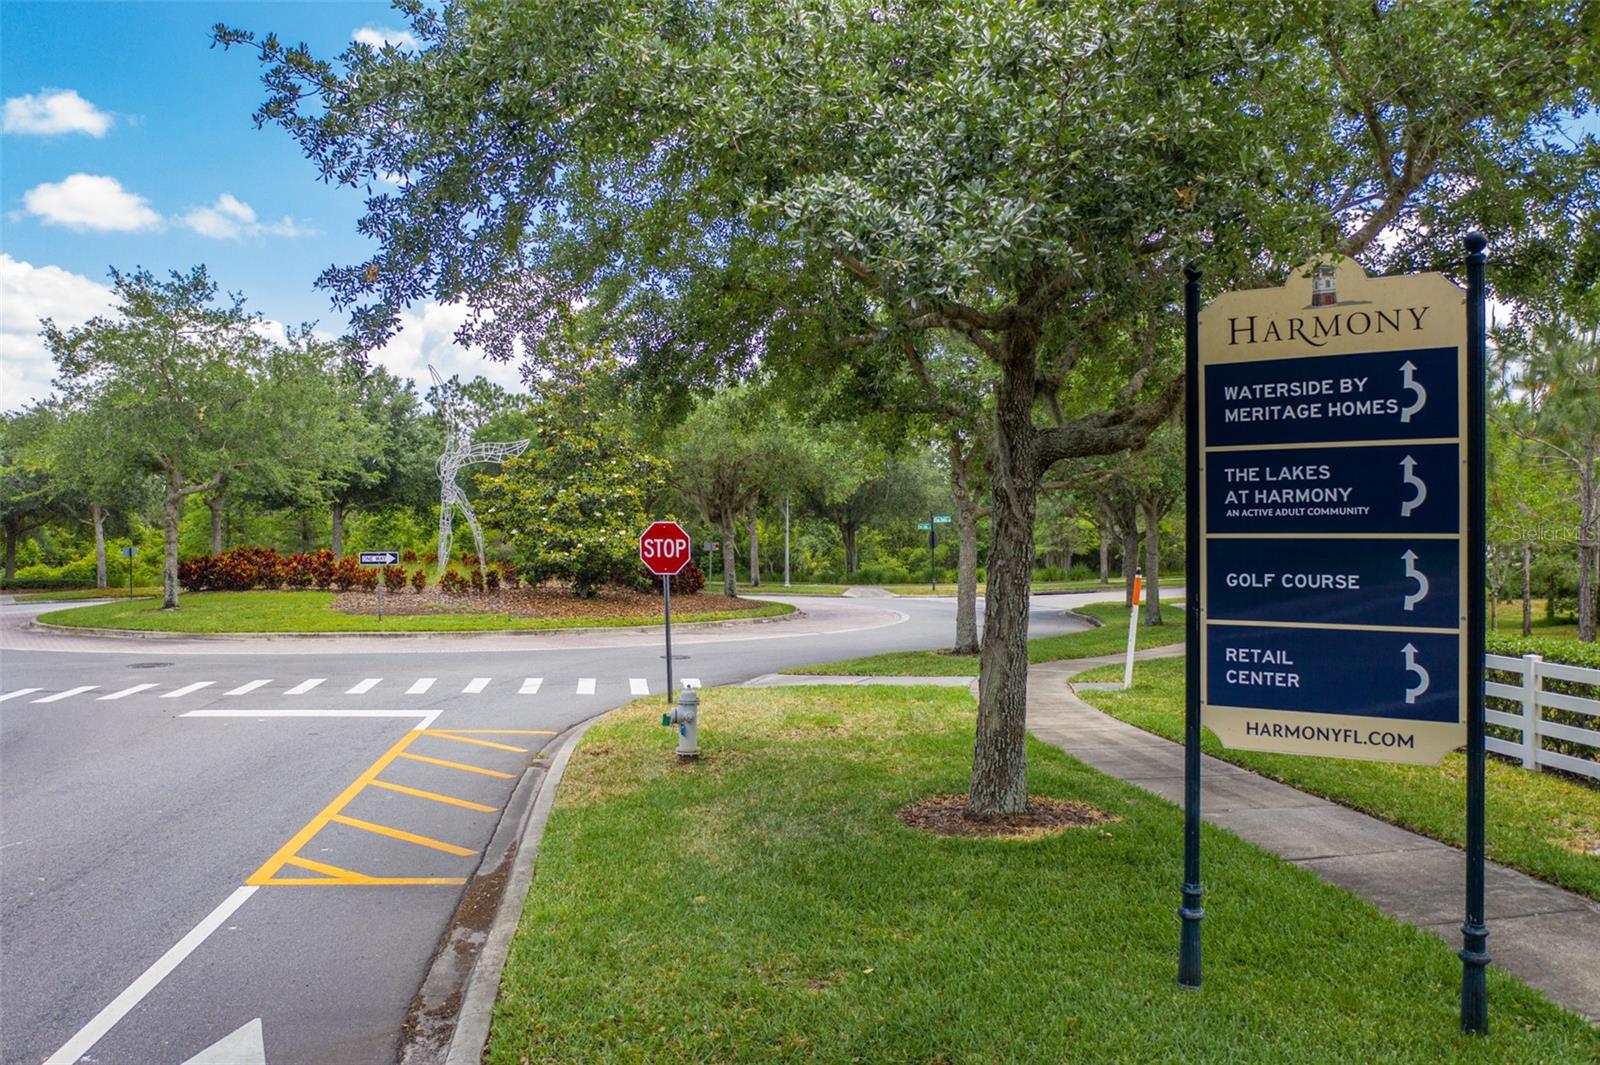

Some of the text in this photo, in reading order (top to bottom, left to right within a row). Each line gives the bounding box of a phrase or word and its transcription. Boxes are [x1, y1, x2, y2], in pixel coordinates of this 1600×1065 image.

[1228, 306, 1431, 347] HARMONY
[1224, 377, 1369, 401] WATERSIDE BY
[1224, 399, 1399, 423] MERITAGE HOMES
[1224, 465, 1331, 482] THE LAKES
[1224, 487, 1353, 505] AT HARMONY
[1226, 506, 1370, 517] AN ACTIVE ADULT COMMUNITY
[643, 538, 687, 558] STOP
[1226, 573, 1360, 590] GOLF COURSE
[1225, 648, 1294, 665] RETAIL
[1225, 670, 1300, 688] CENTER
[1246, 721, 1414, 749] HARMONYFL.COM
